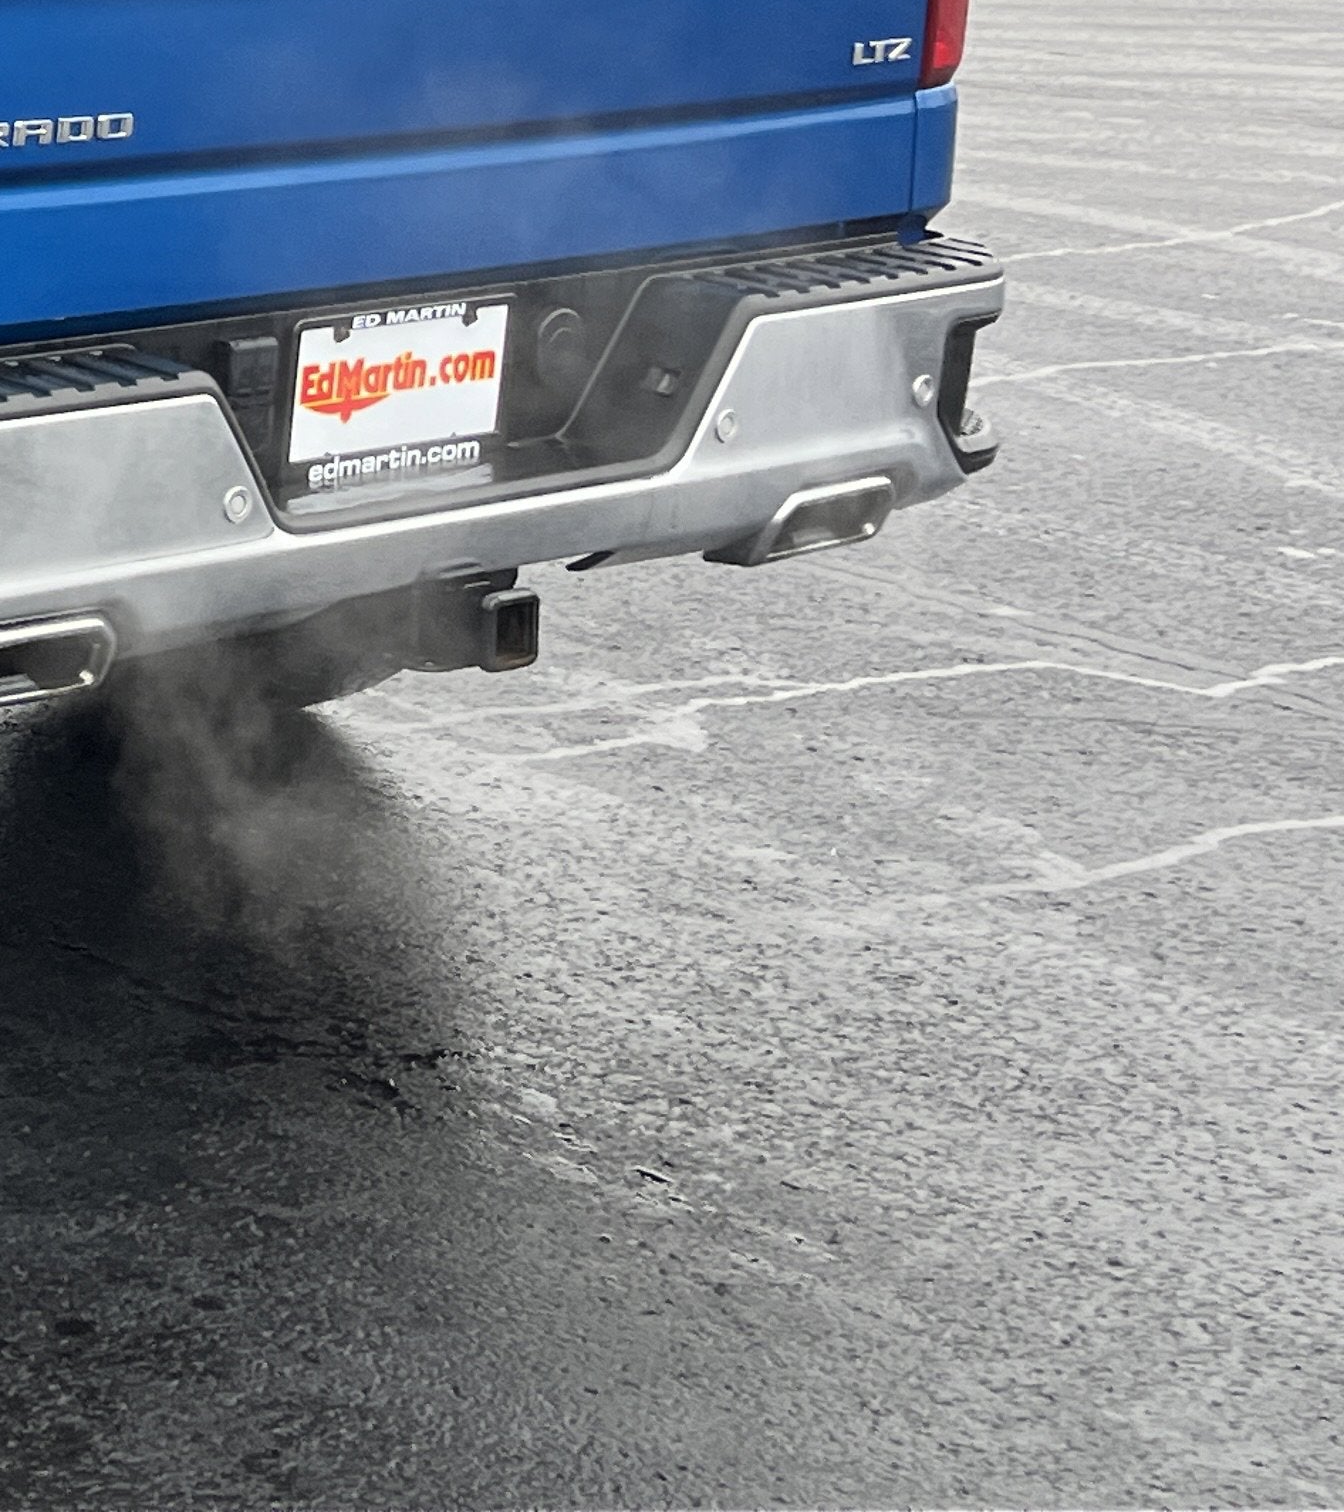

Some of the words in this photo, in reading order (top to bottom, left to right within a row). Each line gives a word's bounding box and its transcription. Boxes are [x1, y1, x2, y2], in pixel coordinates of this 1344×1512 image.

[852, 37, 912, 66] LTZ
[352, 314, 381, 330] ED
[386, 302, 467, 325] MARTIN
[299, 350, 496, 405] EdMartin.com
[308, 440, 481, 483] edmartin.com
